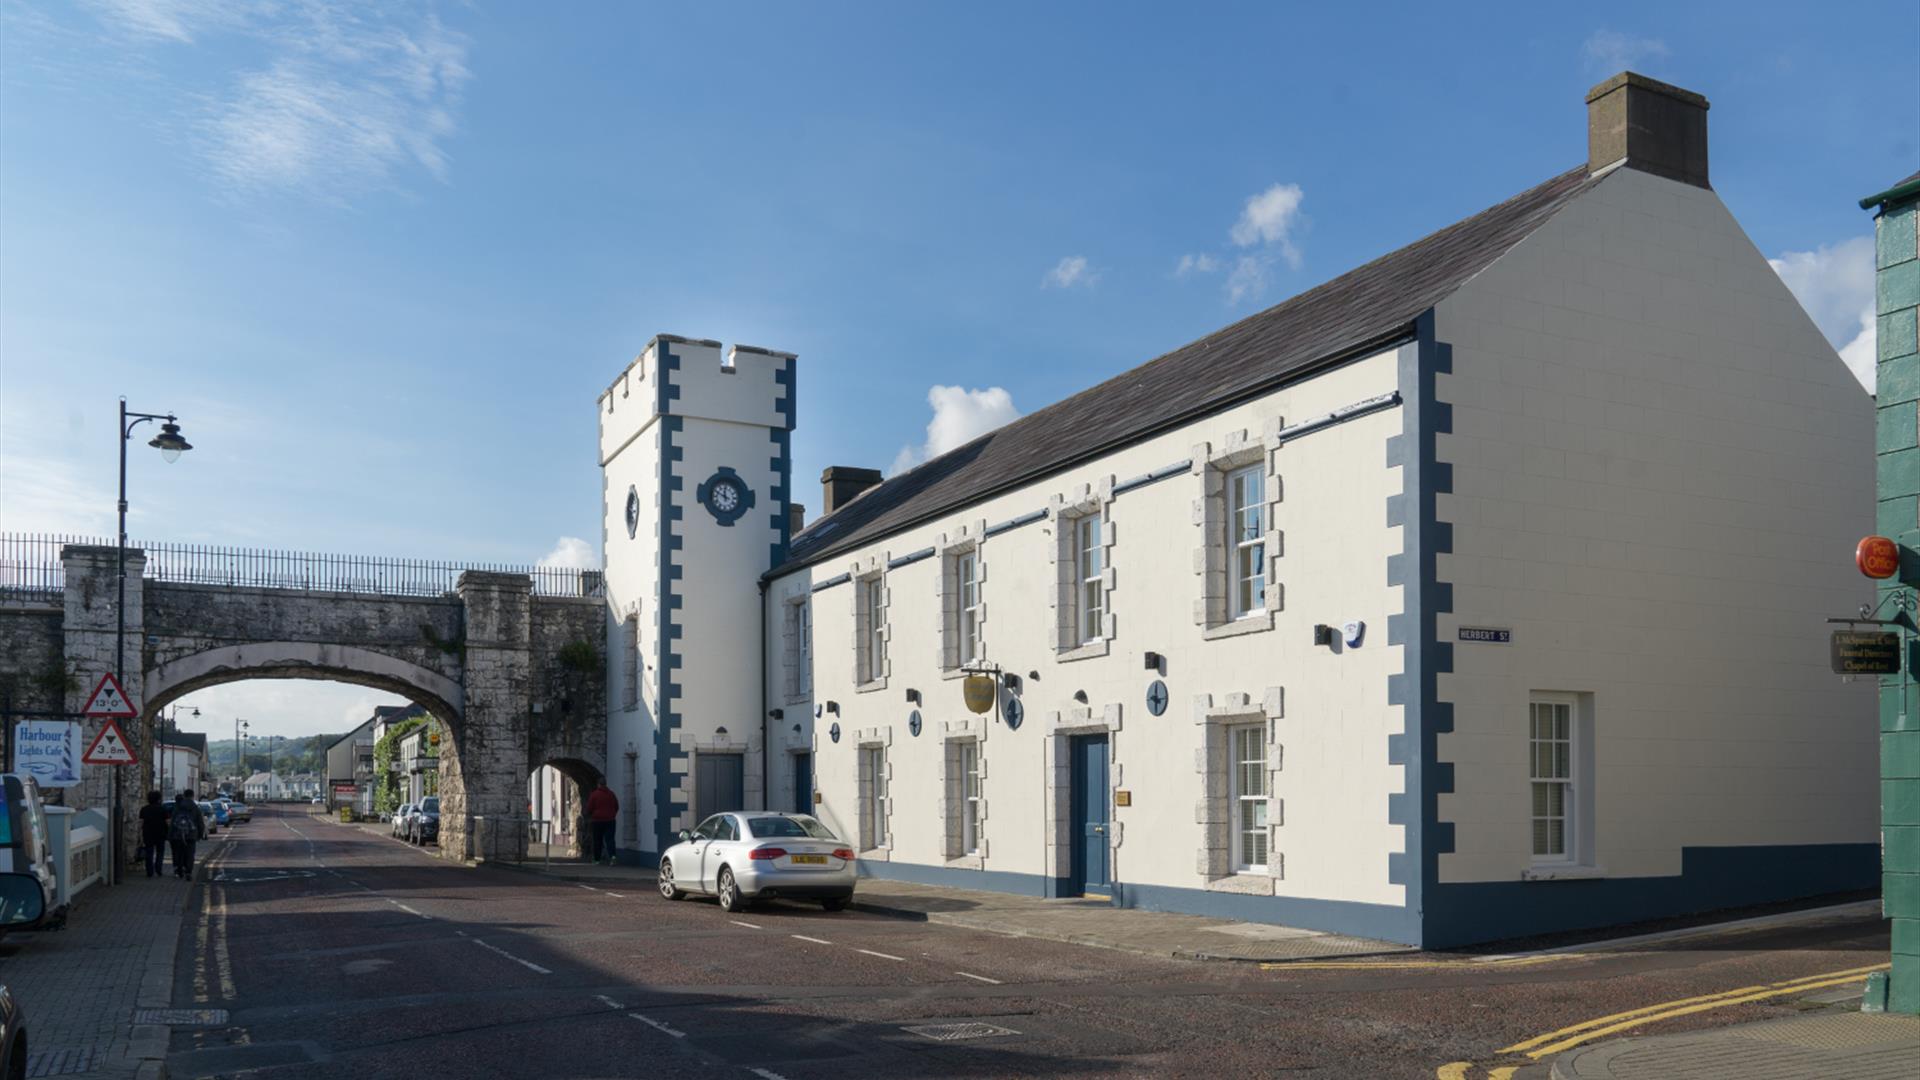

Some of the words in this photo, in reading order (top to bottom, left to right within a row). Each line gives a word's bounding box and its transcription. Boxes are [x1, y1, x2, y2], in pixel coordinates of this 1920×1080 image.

[1872, 543, 1890, 555] Post
[1460, 630, 1495, 640] HERBERT
[20, 727, 62, 741] Harbour
[19, 746, 43, 755] Lights
[97, 745, 125, 754] 3.8m
